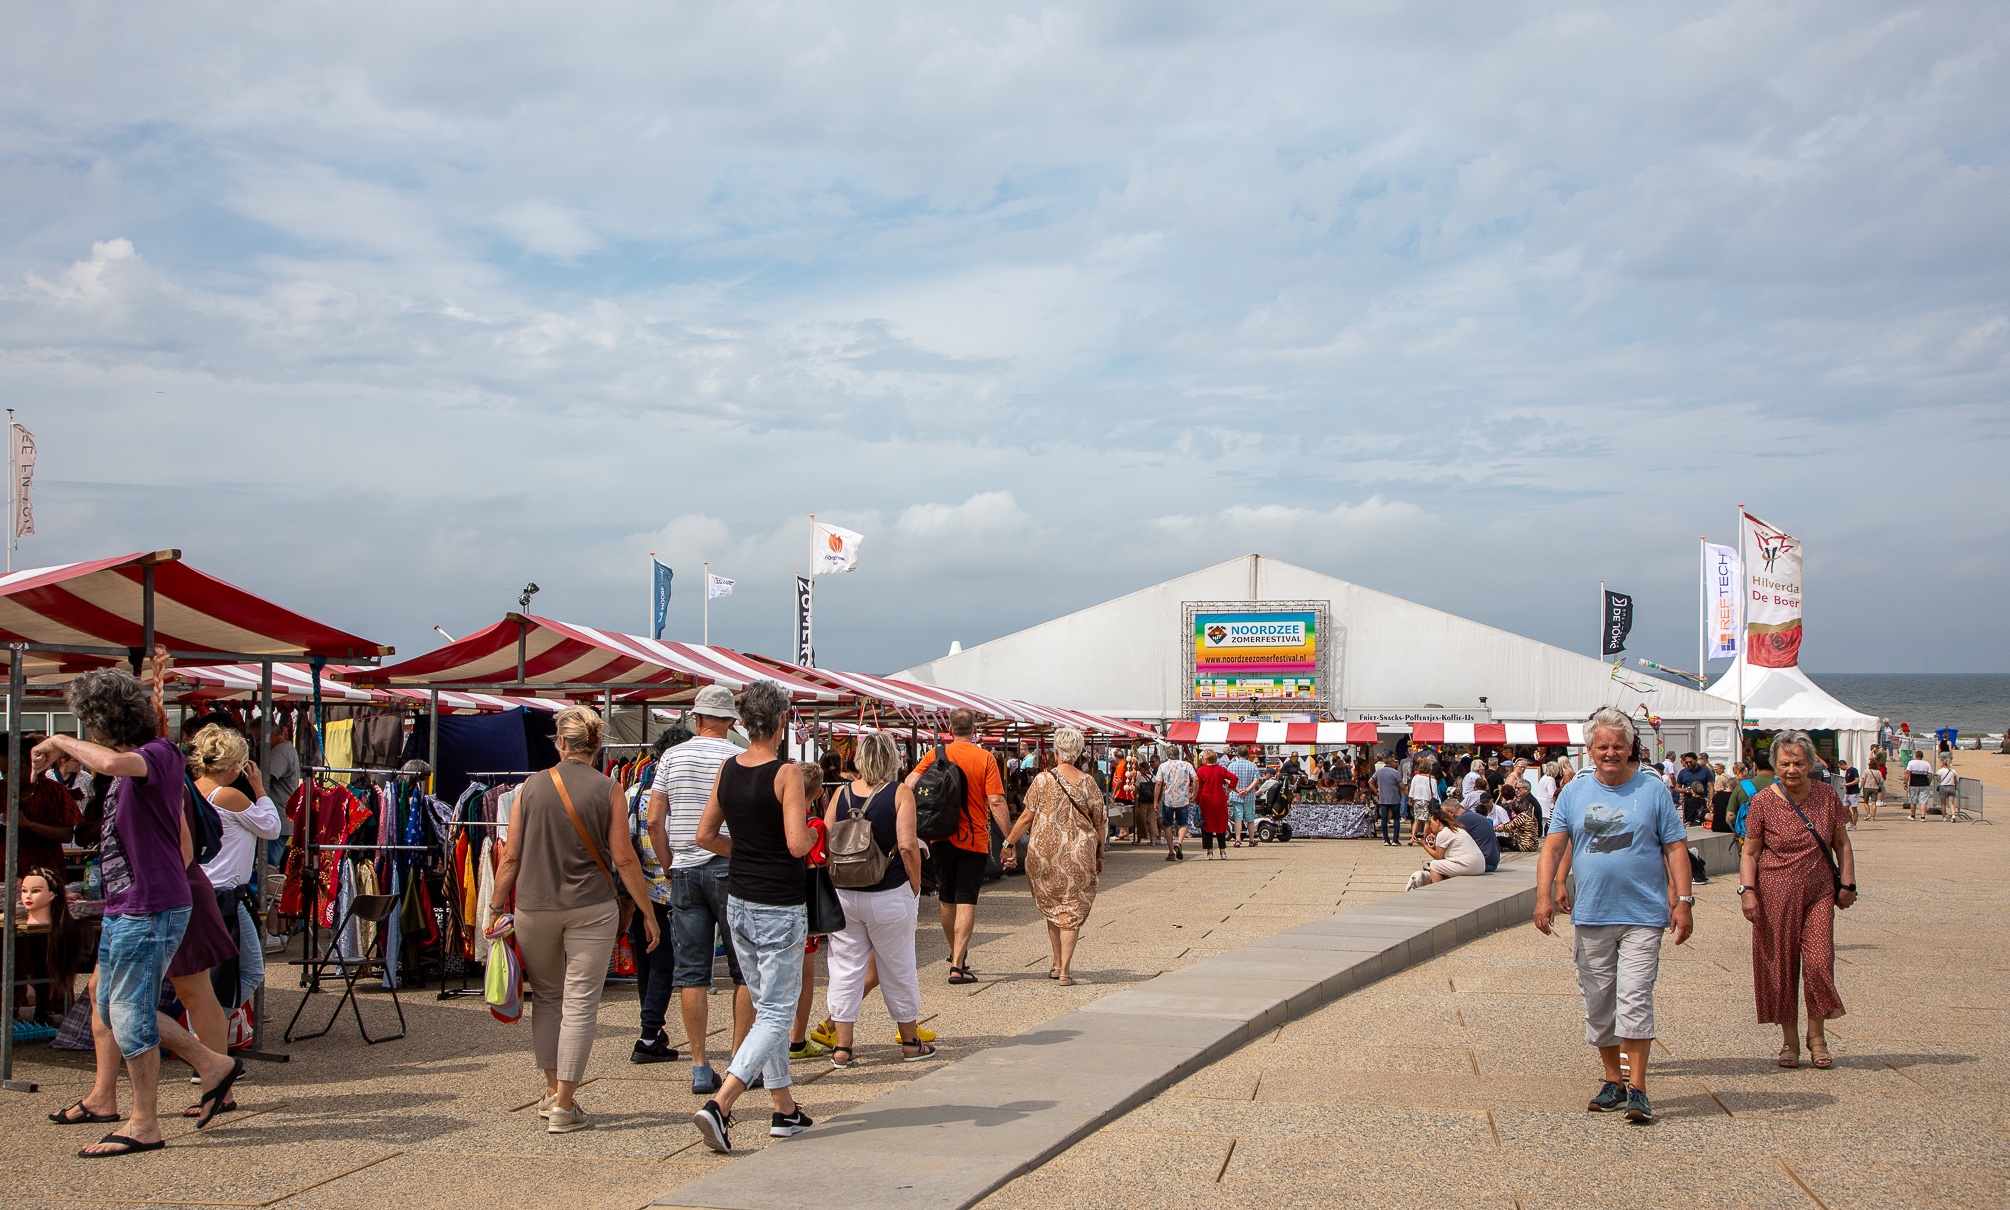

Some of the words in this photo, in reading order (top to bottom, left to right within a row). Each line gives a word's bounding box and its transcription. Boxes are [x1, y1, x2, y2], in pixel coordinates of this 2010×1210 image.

[1752, 575, 1800, 594] Hilverda
[1752, 590, 1768, 603] De
[1774, 595, 1800, 608] Boer
[1231, 625, 1299, 635] NOORDZEE
[1205, 654, 1306, 663] www.noordzeezomerfestival.nl
